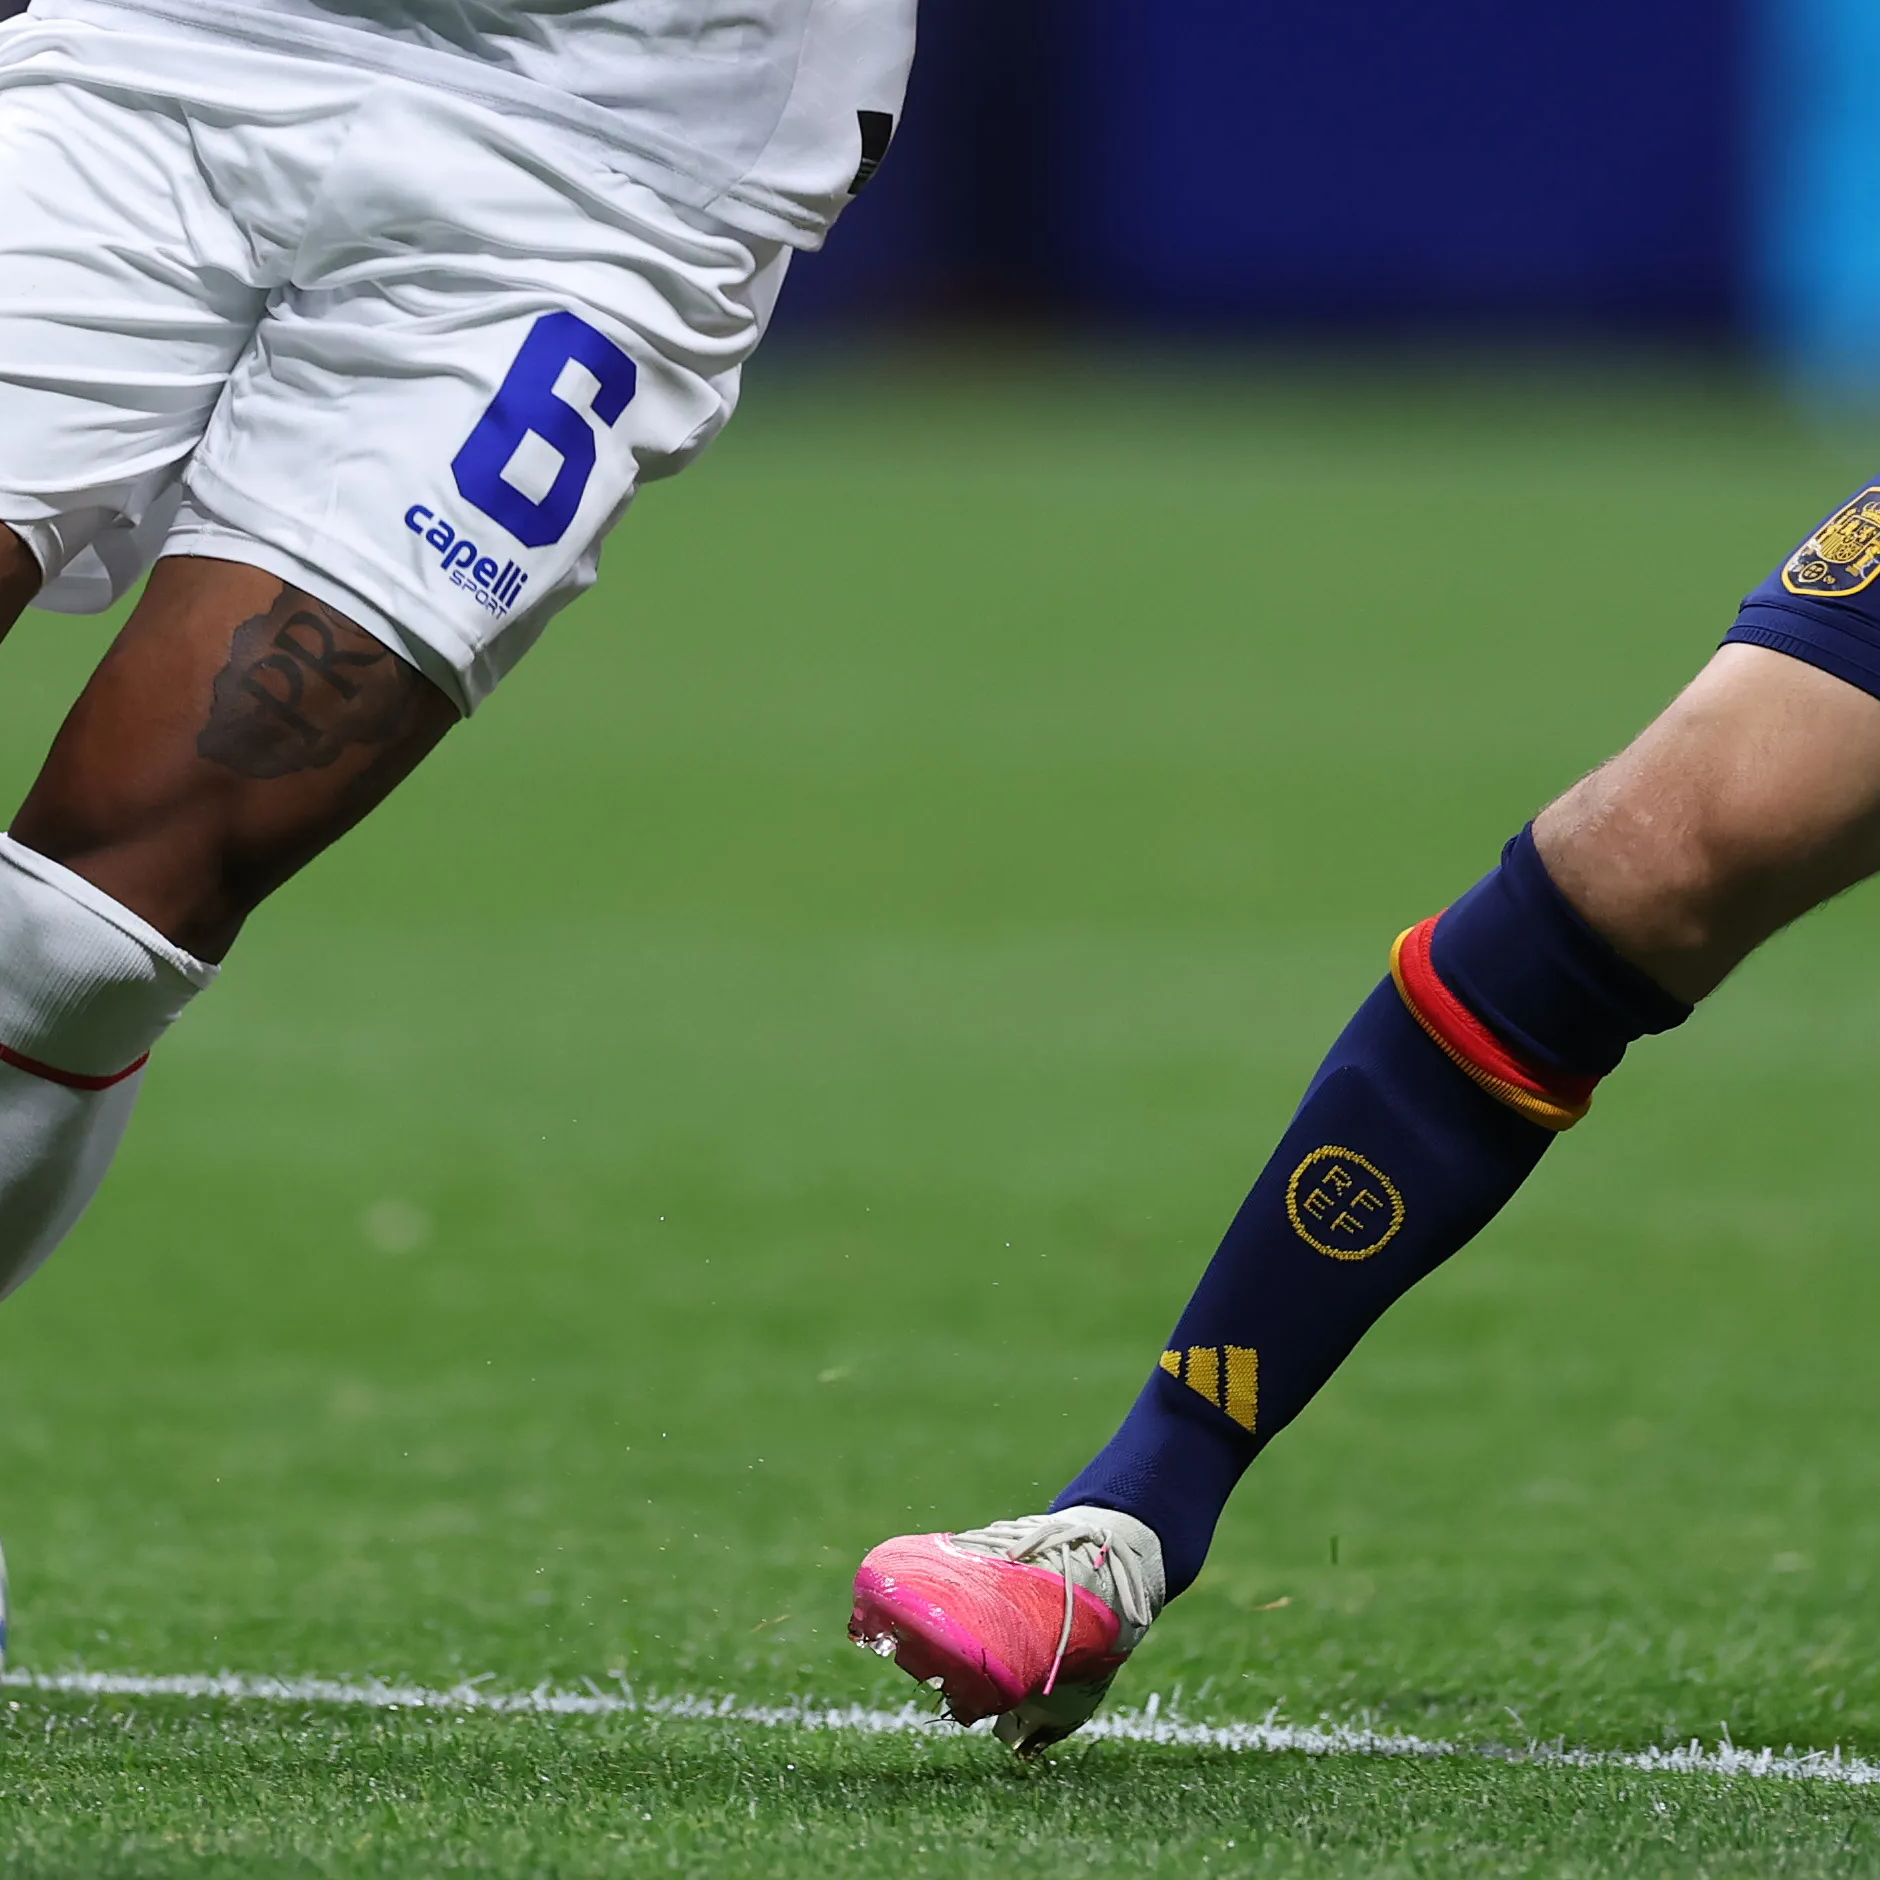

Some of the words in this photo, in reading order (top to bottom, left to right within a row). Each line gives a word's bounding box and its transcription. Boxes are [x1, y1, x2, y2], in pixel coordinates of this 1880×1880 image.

[450, 310, 638, 549] 6
[404, 504, 529, 609] capelli
[449, 570, 508, 620] SPORT
